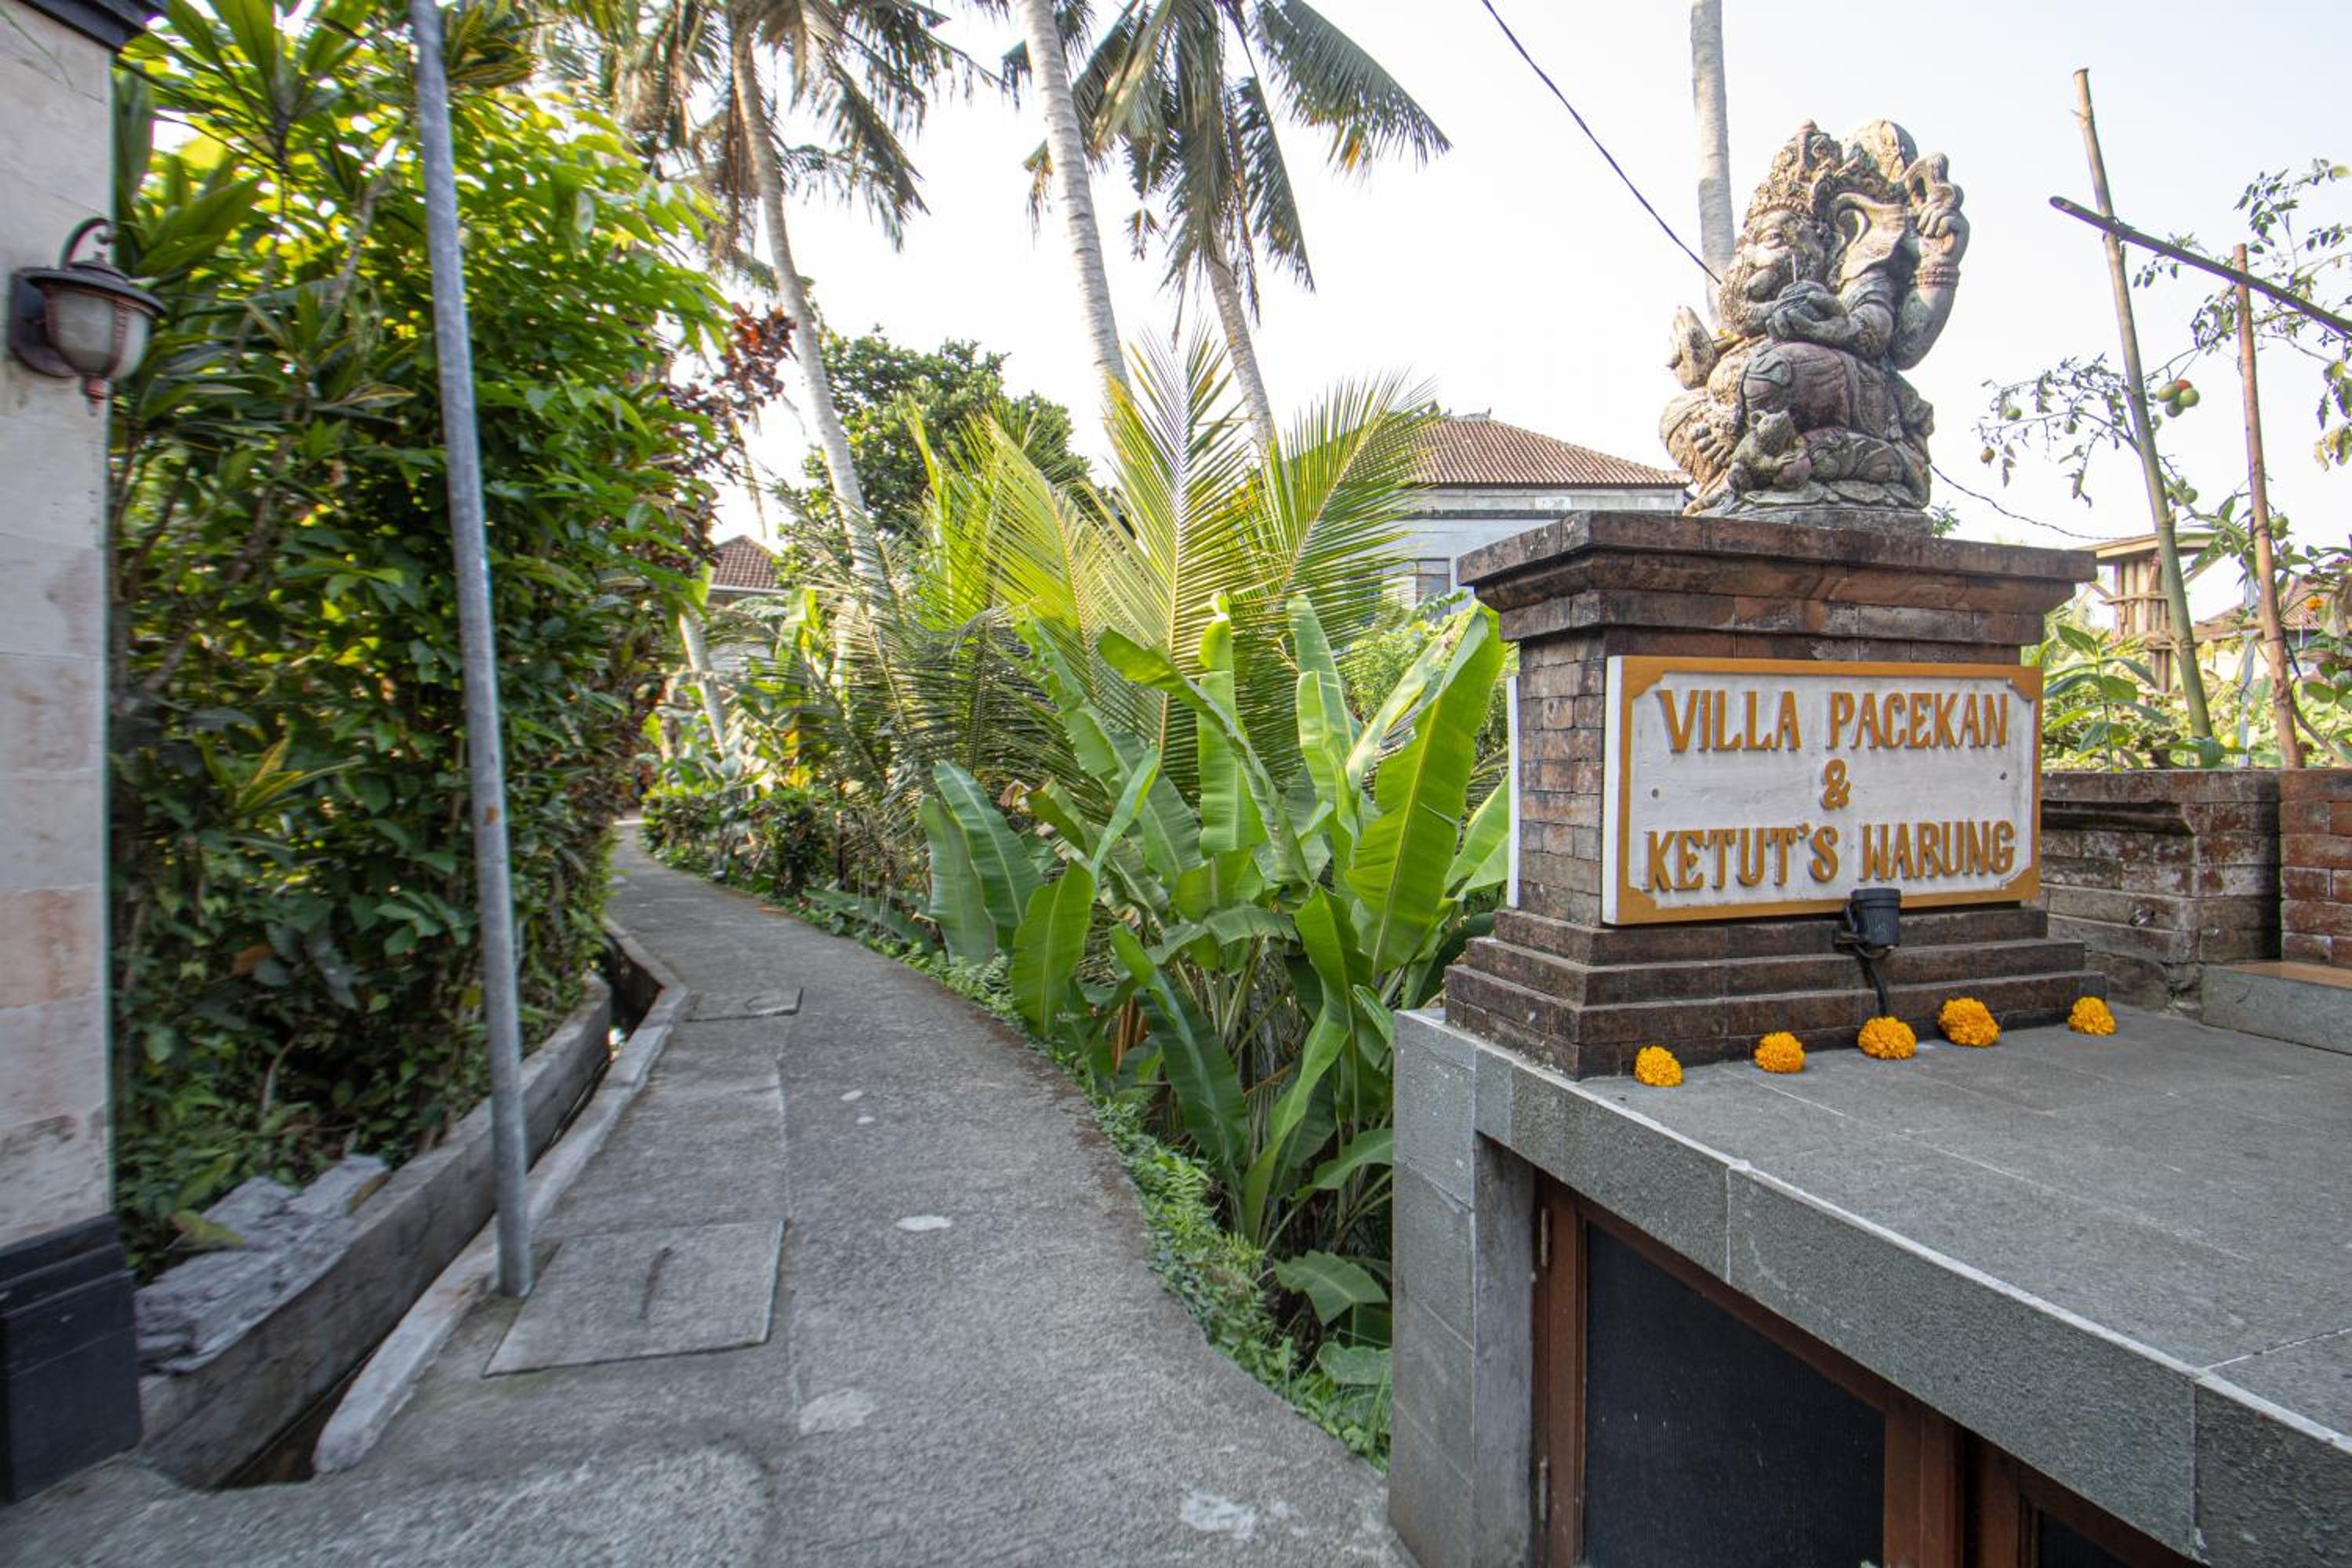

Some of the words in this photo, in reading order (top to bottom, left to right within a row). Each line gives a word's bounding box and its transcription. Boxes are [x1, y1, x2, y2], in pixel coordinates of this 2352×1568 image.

[1657, 689, 1801, 753] VILLA
[1826, 691, 2008, 750] PACEKAN
[1820, 758, 1851, 811] &
[1644, 823, 1838, 892] KETUT'S
[1858, 820, 2016, 881] WARUNG
